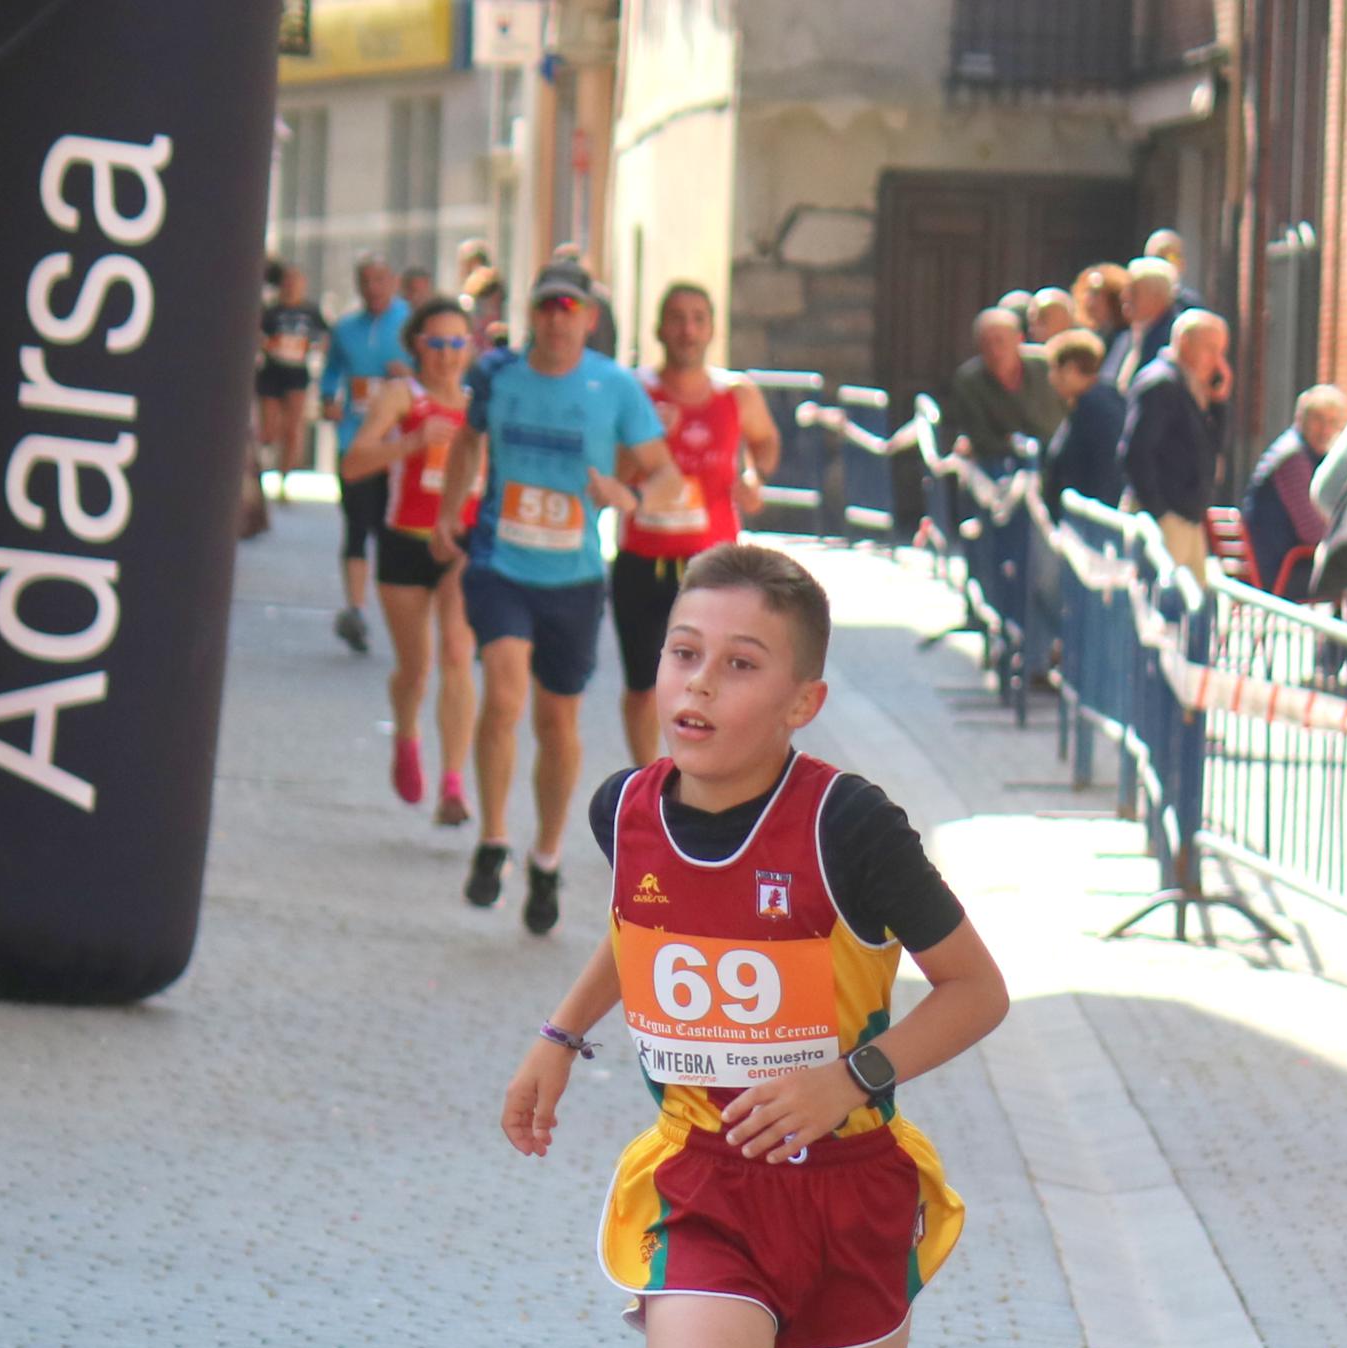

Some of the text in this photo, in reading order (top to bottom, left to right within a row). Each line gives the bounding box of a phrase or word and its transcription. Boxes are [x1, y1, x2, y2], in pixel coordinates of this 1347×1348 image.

[653, 943, 782, 1024] 69
[638, 1012, 672, 1034] Legua
[675, 1022, 746, 1040] Castellana
[750, 1026, 770, 1040] del
[774, 1025, 829, 1039] Cerrato
[653, 1049, 716, 1075] INTEGRA
[726, 1049, 824, 1066] Eres nuestra
